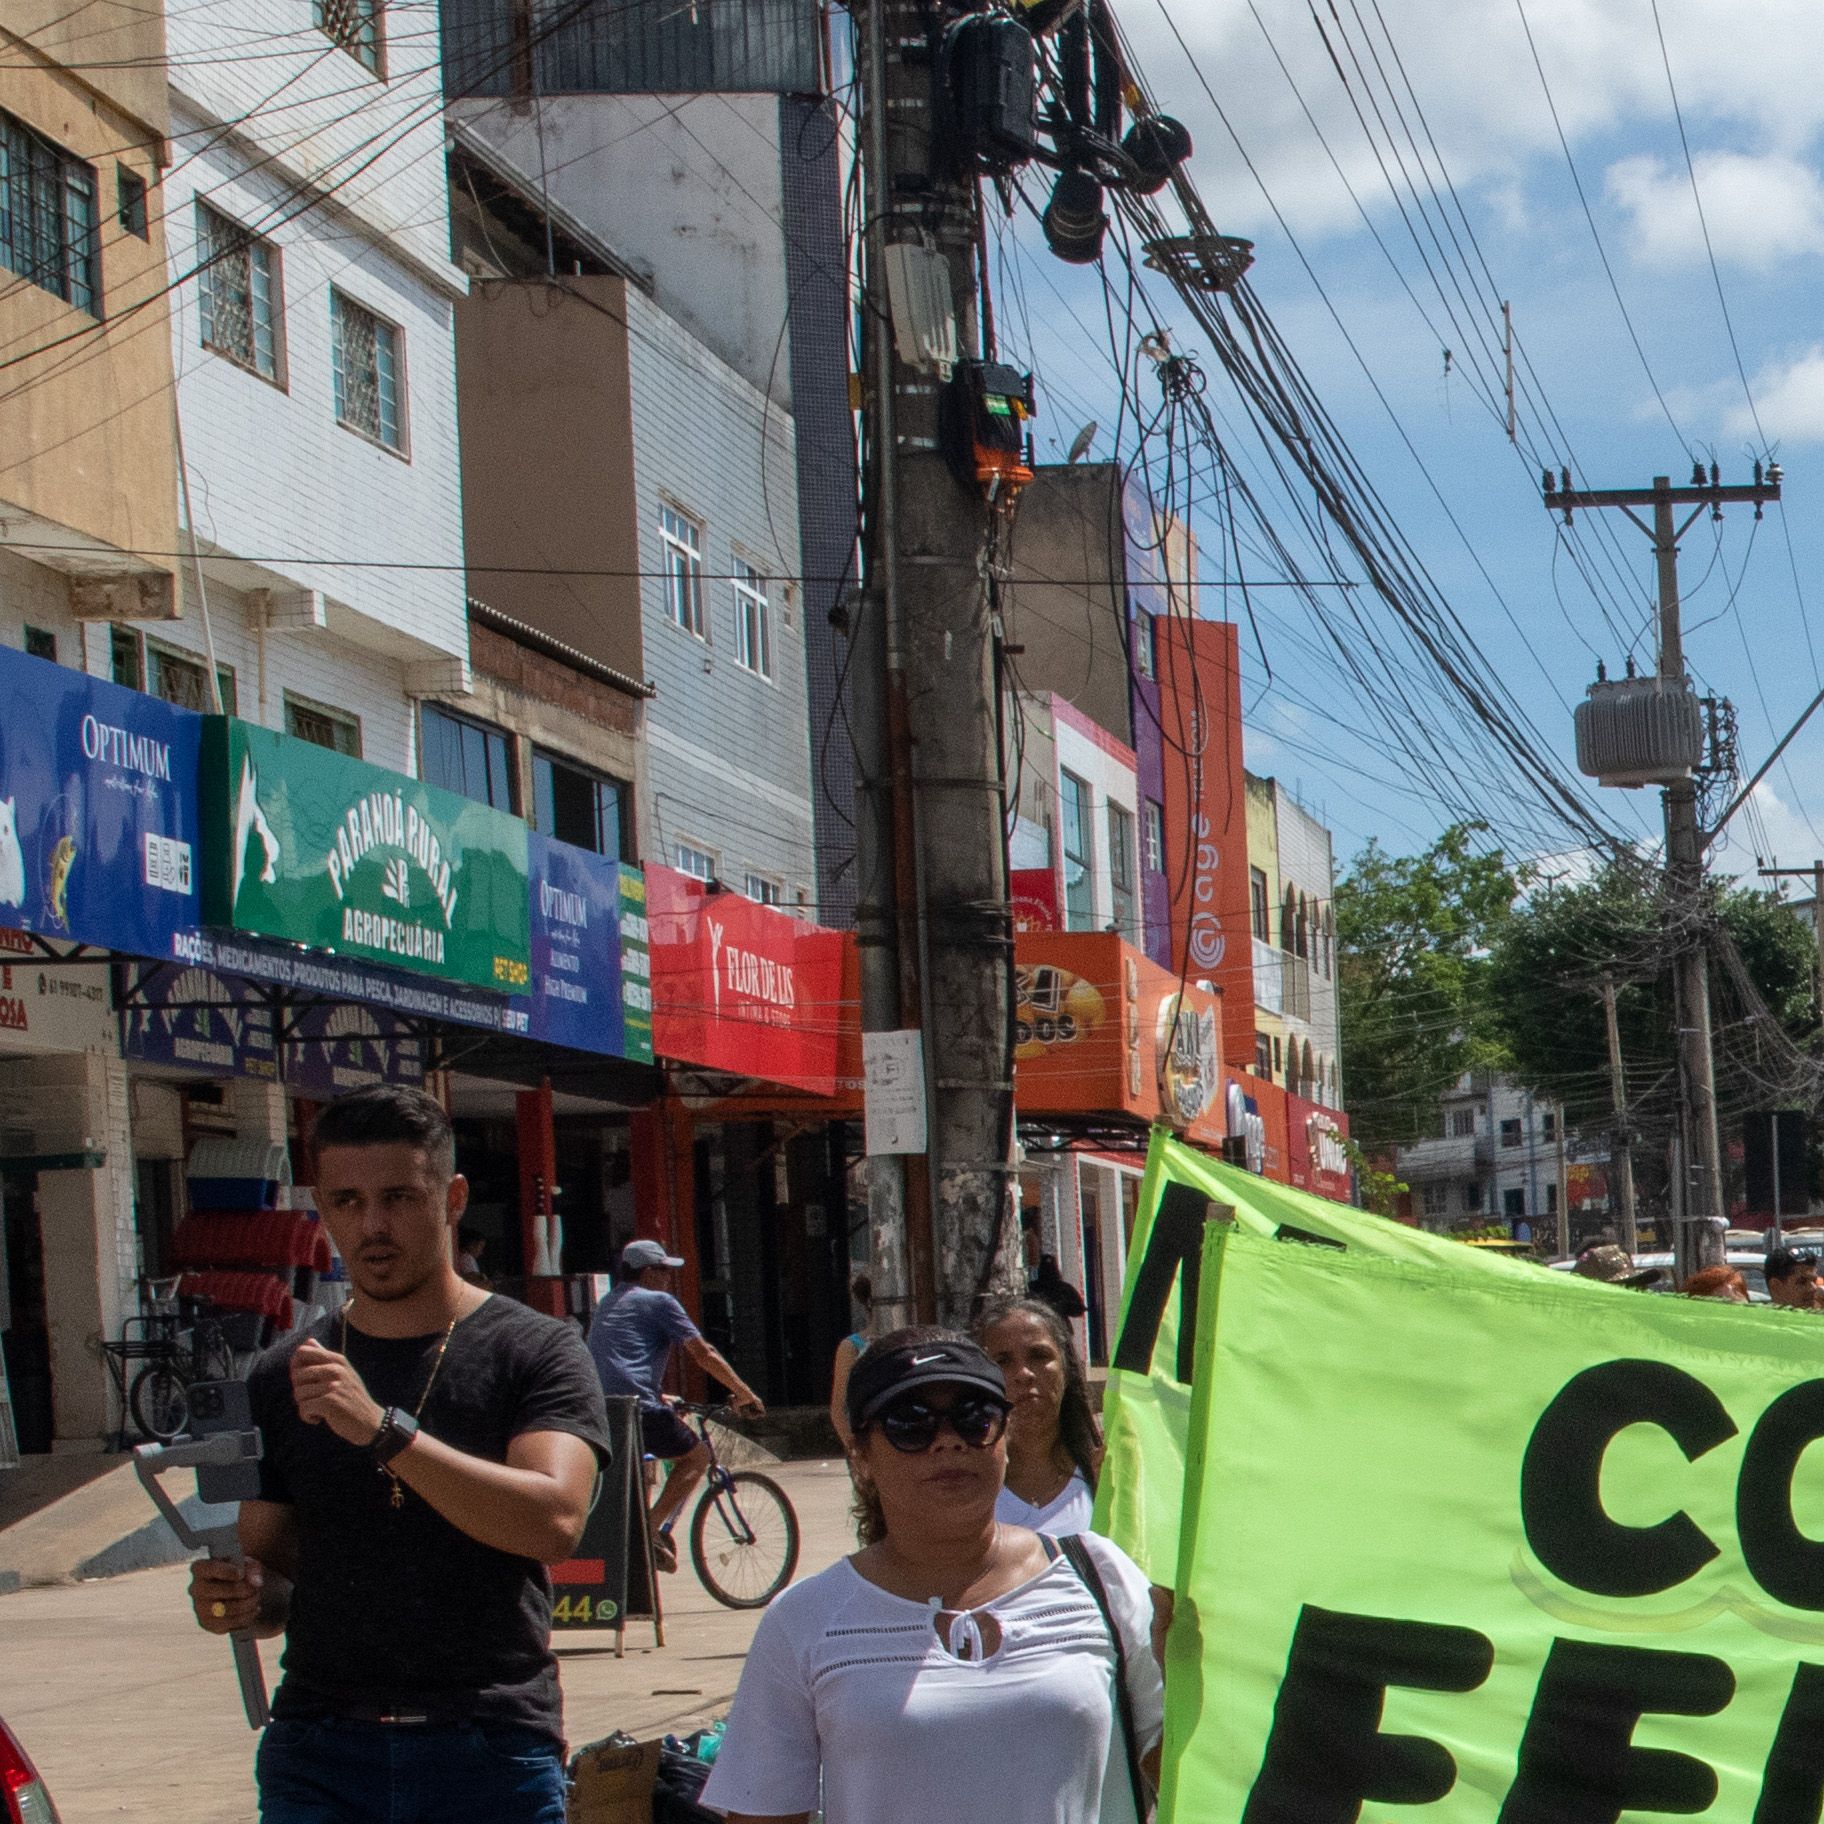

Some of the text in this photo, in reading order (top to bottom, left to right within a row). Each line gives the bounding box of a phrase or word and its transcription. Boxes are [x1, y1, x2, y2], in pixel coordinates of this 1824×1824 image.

[82, 714, 172, 782] OPTIMUM
[326, 787, 405, 901] PARANOÁ
[406, 804, 458, 930] RURAL
[343, 907, 446, 965] AGROPECUÁRIA
[540, 879, 588, 929] OPTIMUM
[725, 945, 796, 1010] FLOR DE LIS
[551, 1595, 592, 1623] 44
